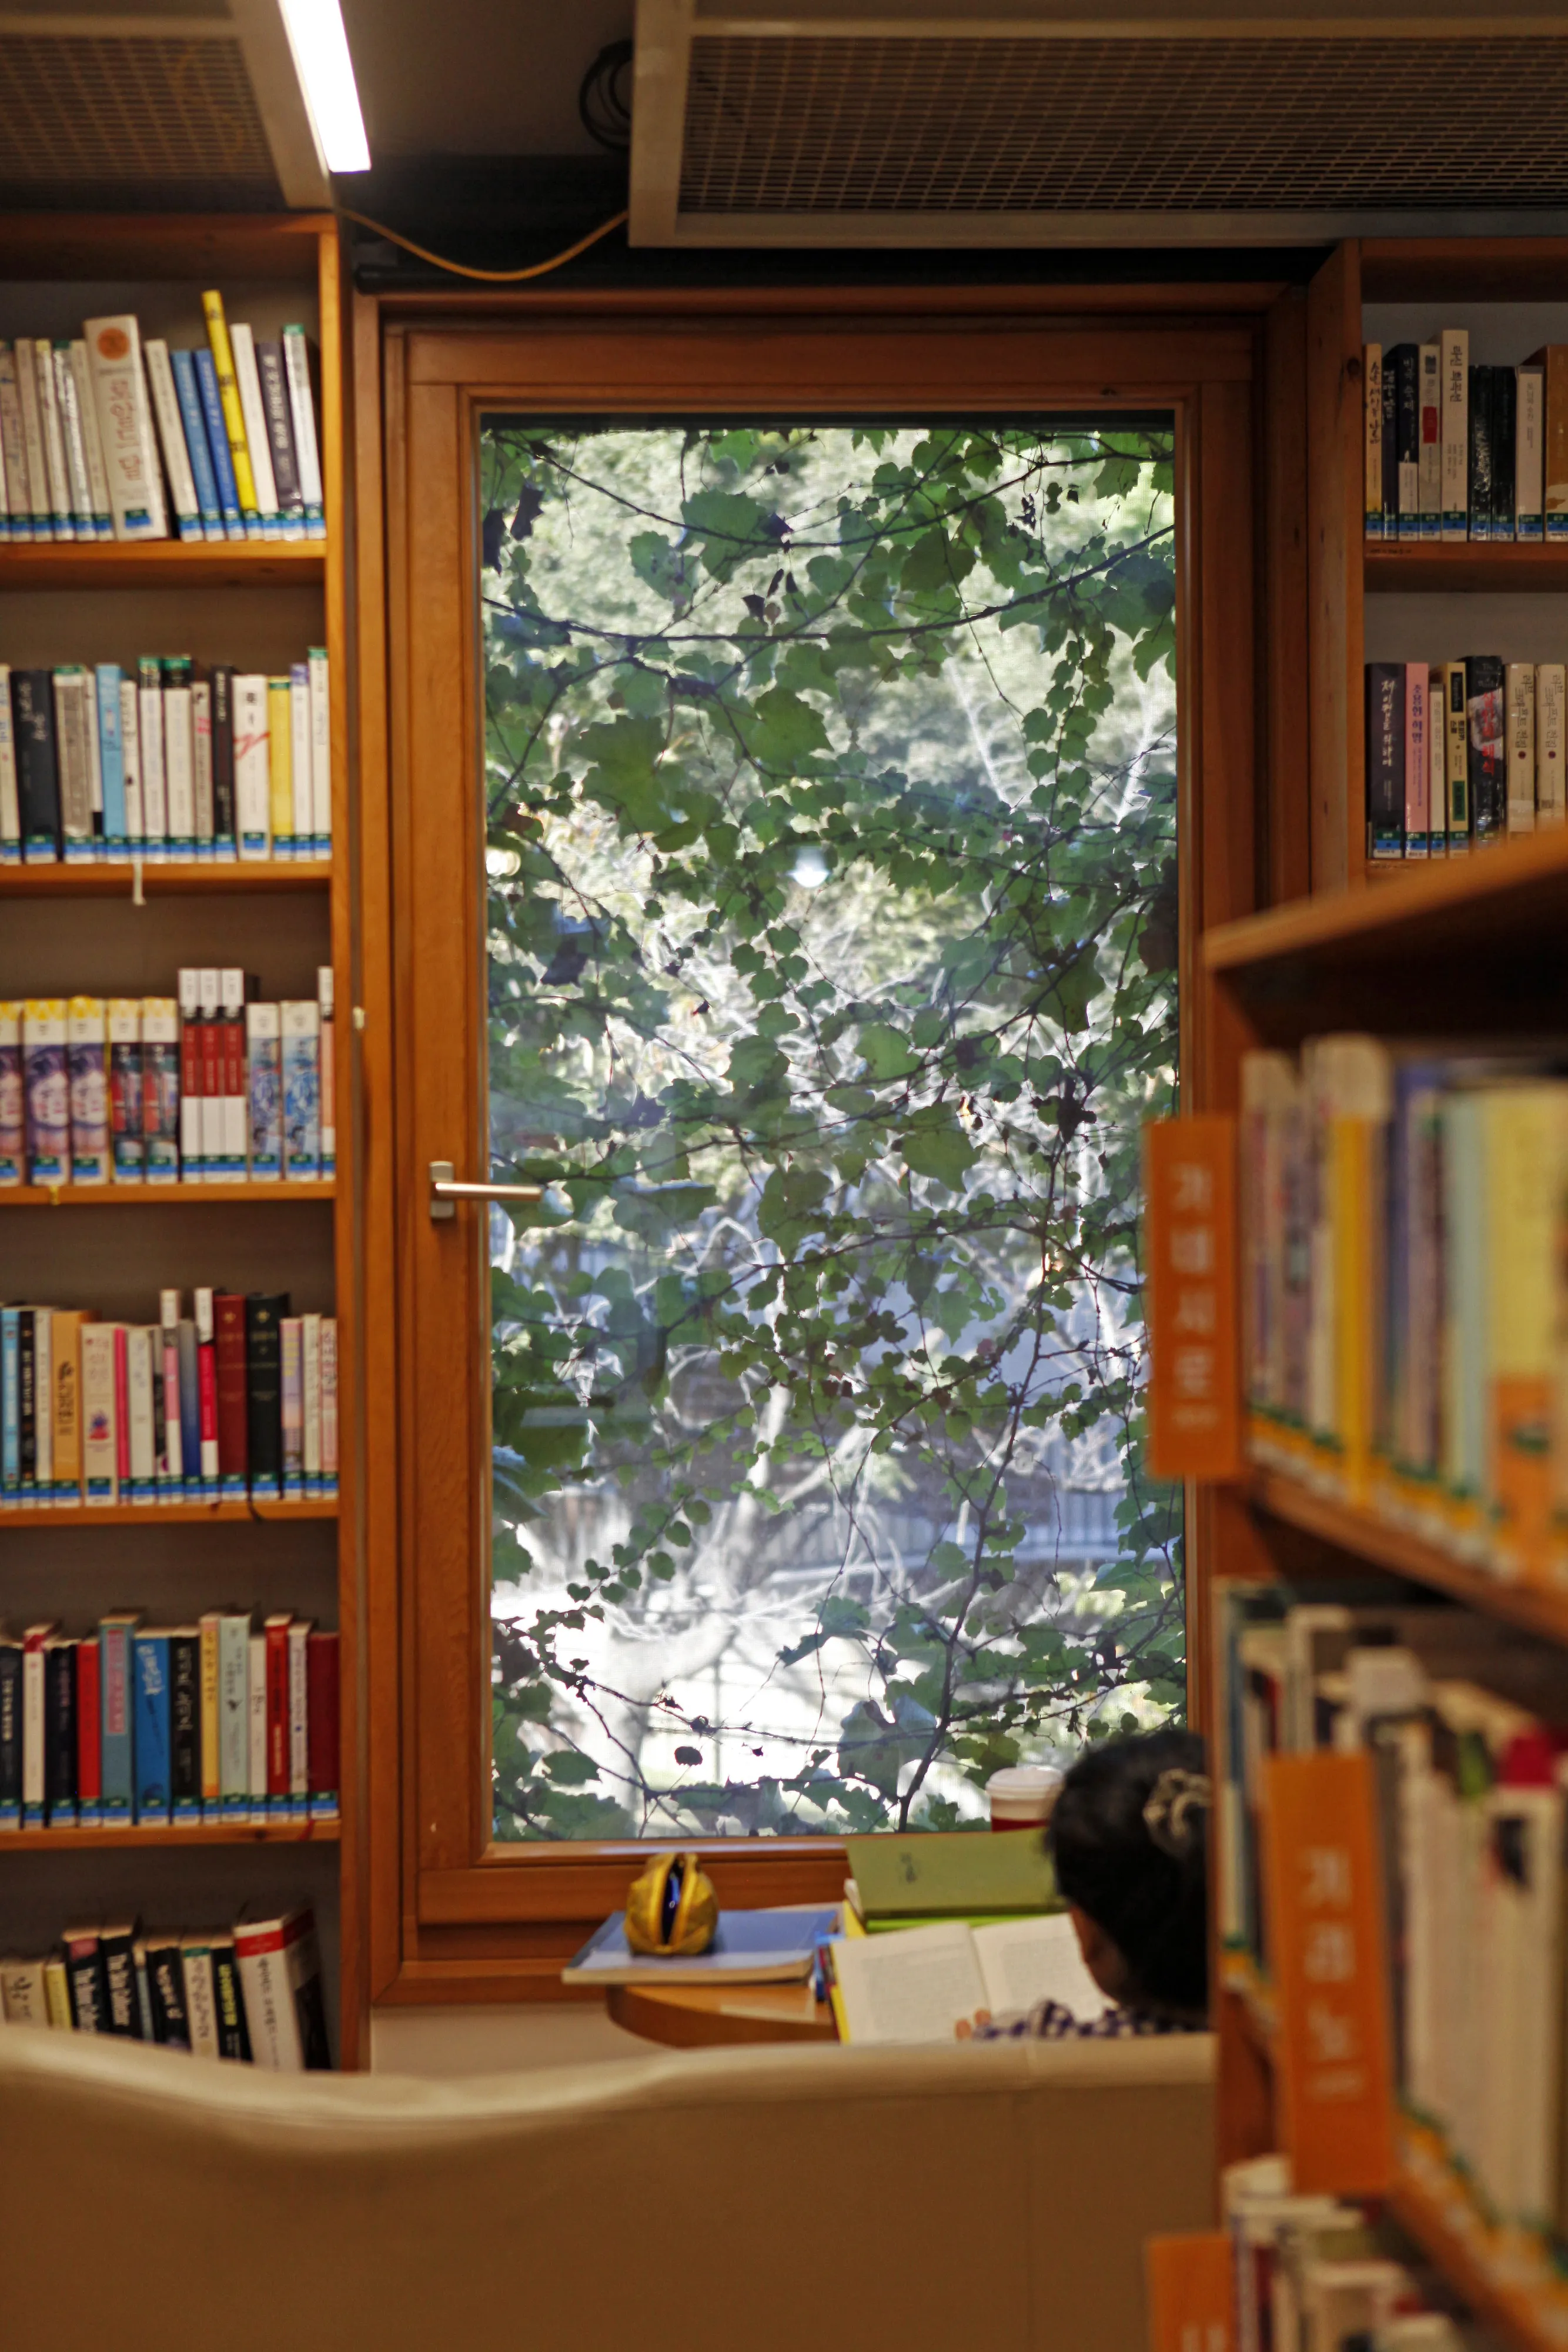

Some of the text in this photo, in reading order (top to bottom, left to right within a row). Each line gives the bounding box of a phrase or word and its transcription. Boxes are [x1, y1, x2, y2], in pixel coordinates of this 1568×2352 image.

[1449, 345, 1463, 403] 라신 희곡선
[1412, 684, 1423, 717] 조용한
[1512, 674, 1534, 728] 러브크래프트
[1542, 674, 1564, 749] 러브크래프트 전집
[1482, 743, 1495, 777] 해석
[1515, 729, 1529, 749] 전집
